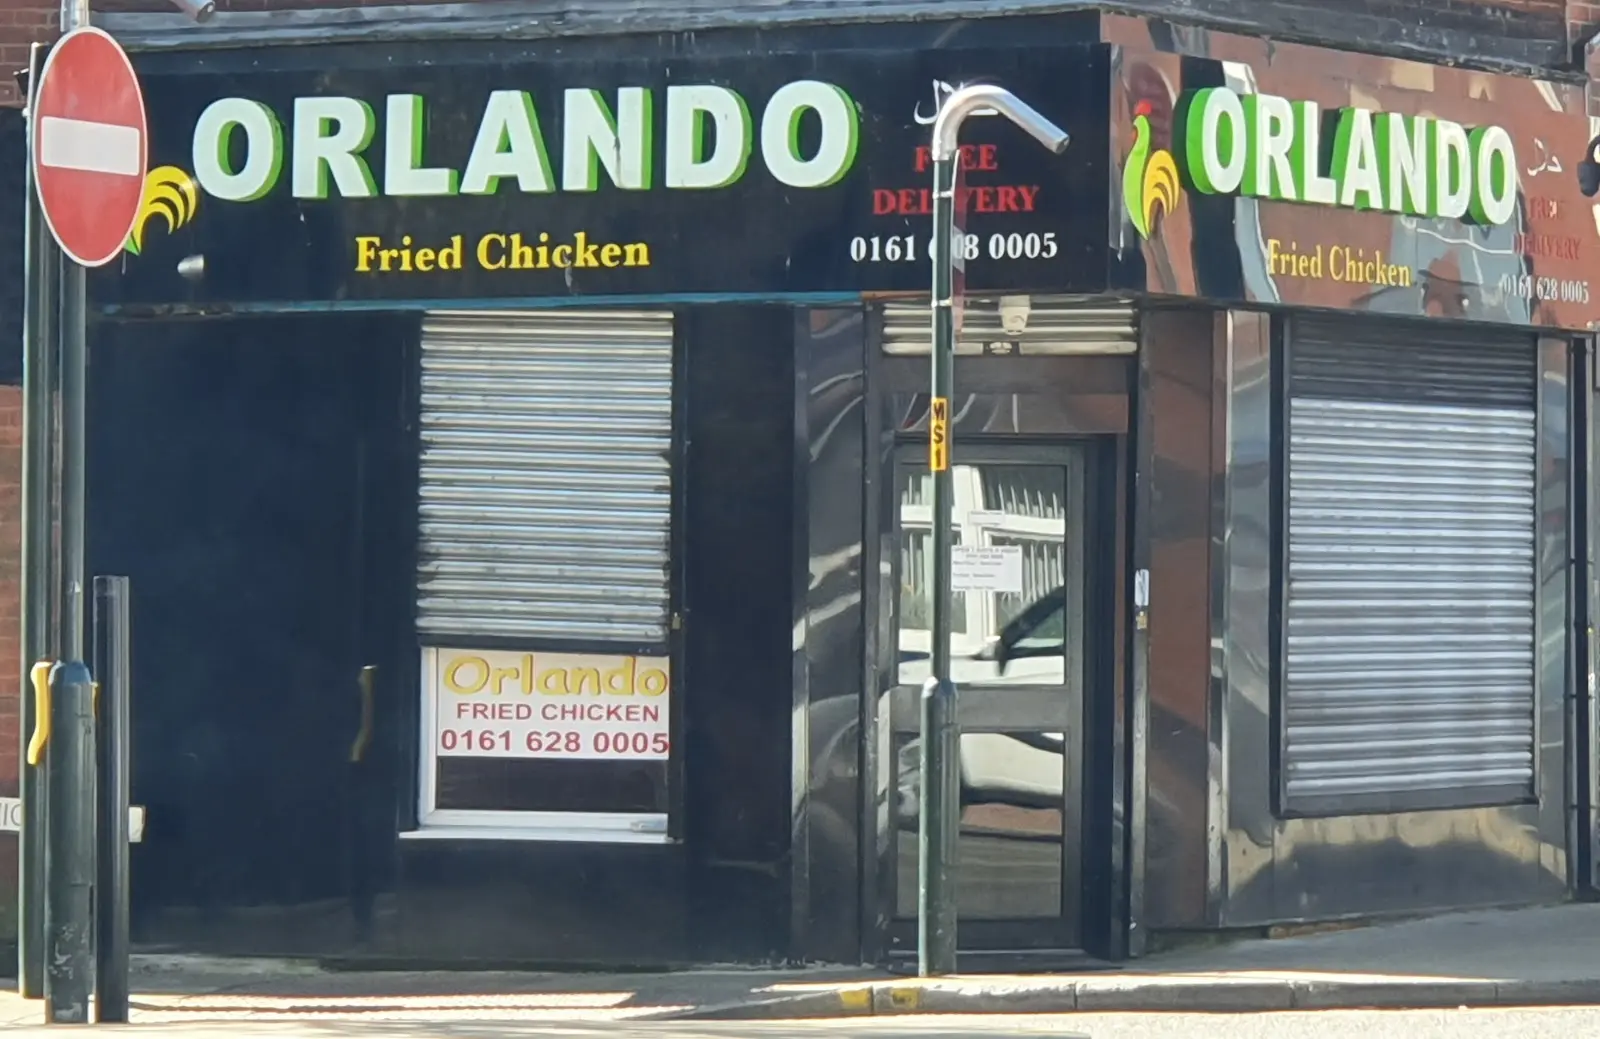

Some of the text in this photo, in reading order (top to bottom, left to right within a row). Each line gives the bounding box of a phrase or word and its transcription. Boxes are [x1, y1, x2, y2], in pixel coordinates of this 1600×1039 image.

[193, 80, 859, 201] ORLANDO
[914, 144, 998, 173] FEE
[1186, 86, 1517, 226] ORLANDO
[872, 185, 1040, 215] DELVERY
[355, 231, 650, 272] Fried Chicken
[850, 235, 917, 262] 0161
[988, 232, 1058, 260] 0005
[1266, 238, 1412, 287] Fried Chicken
[1536, 277, 1559, 301] 628
[1561, 280, 1590, 305] 0005
[443, 654, 668, 696] Orlando
[456, 703, 659, 722] FRIED CHICKEN
[441, 729, 670, 754] 0161 628 0005
